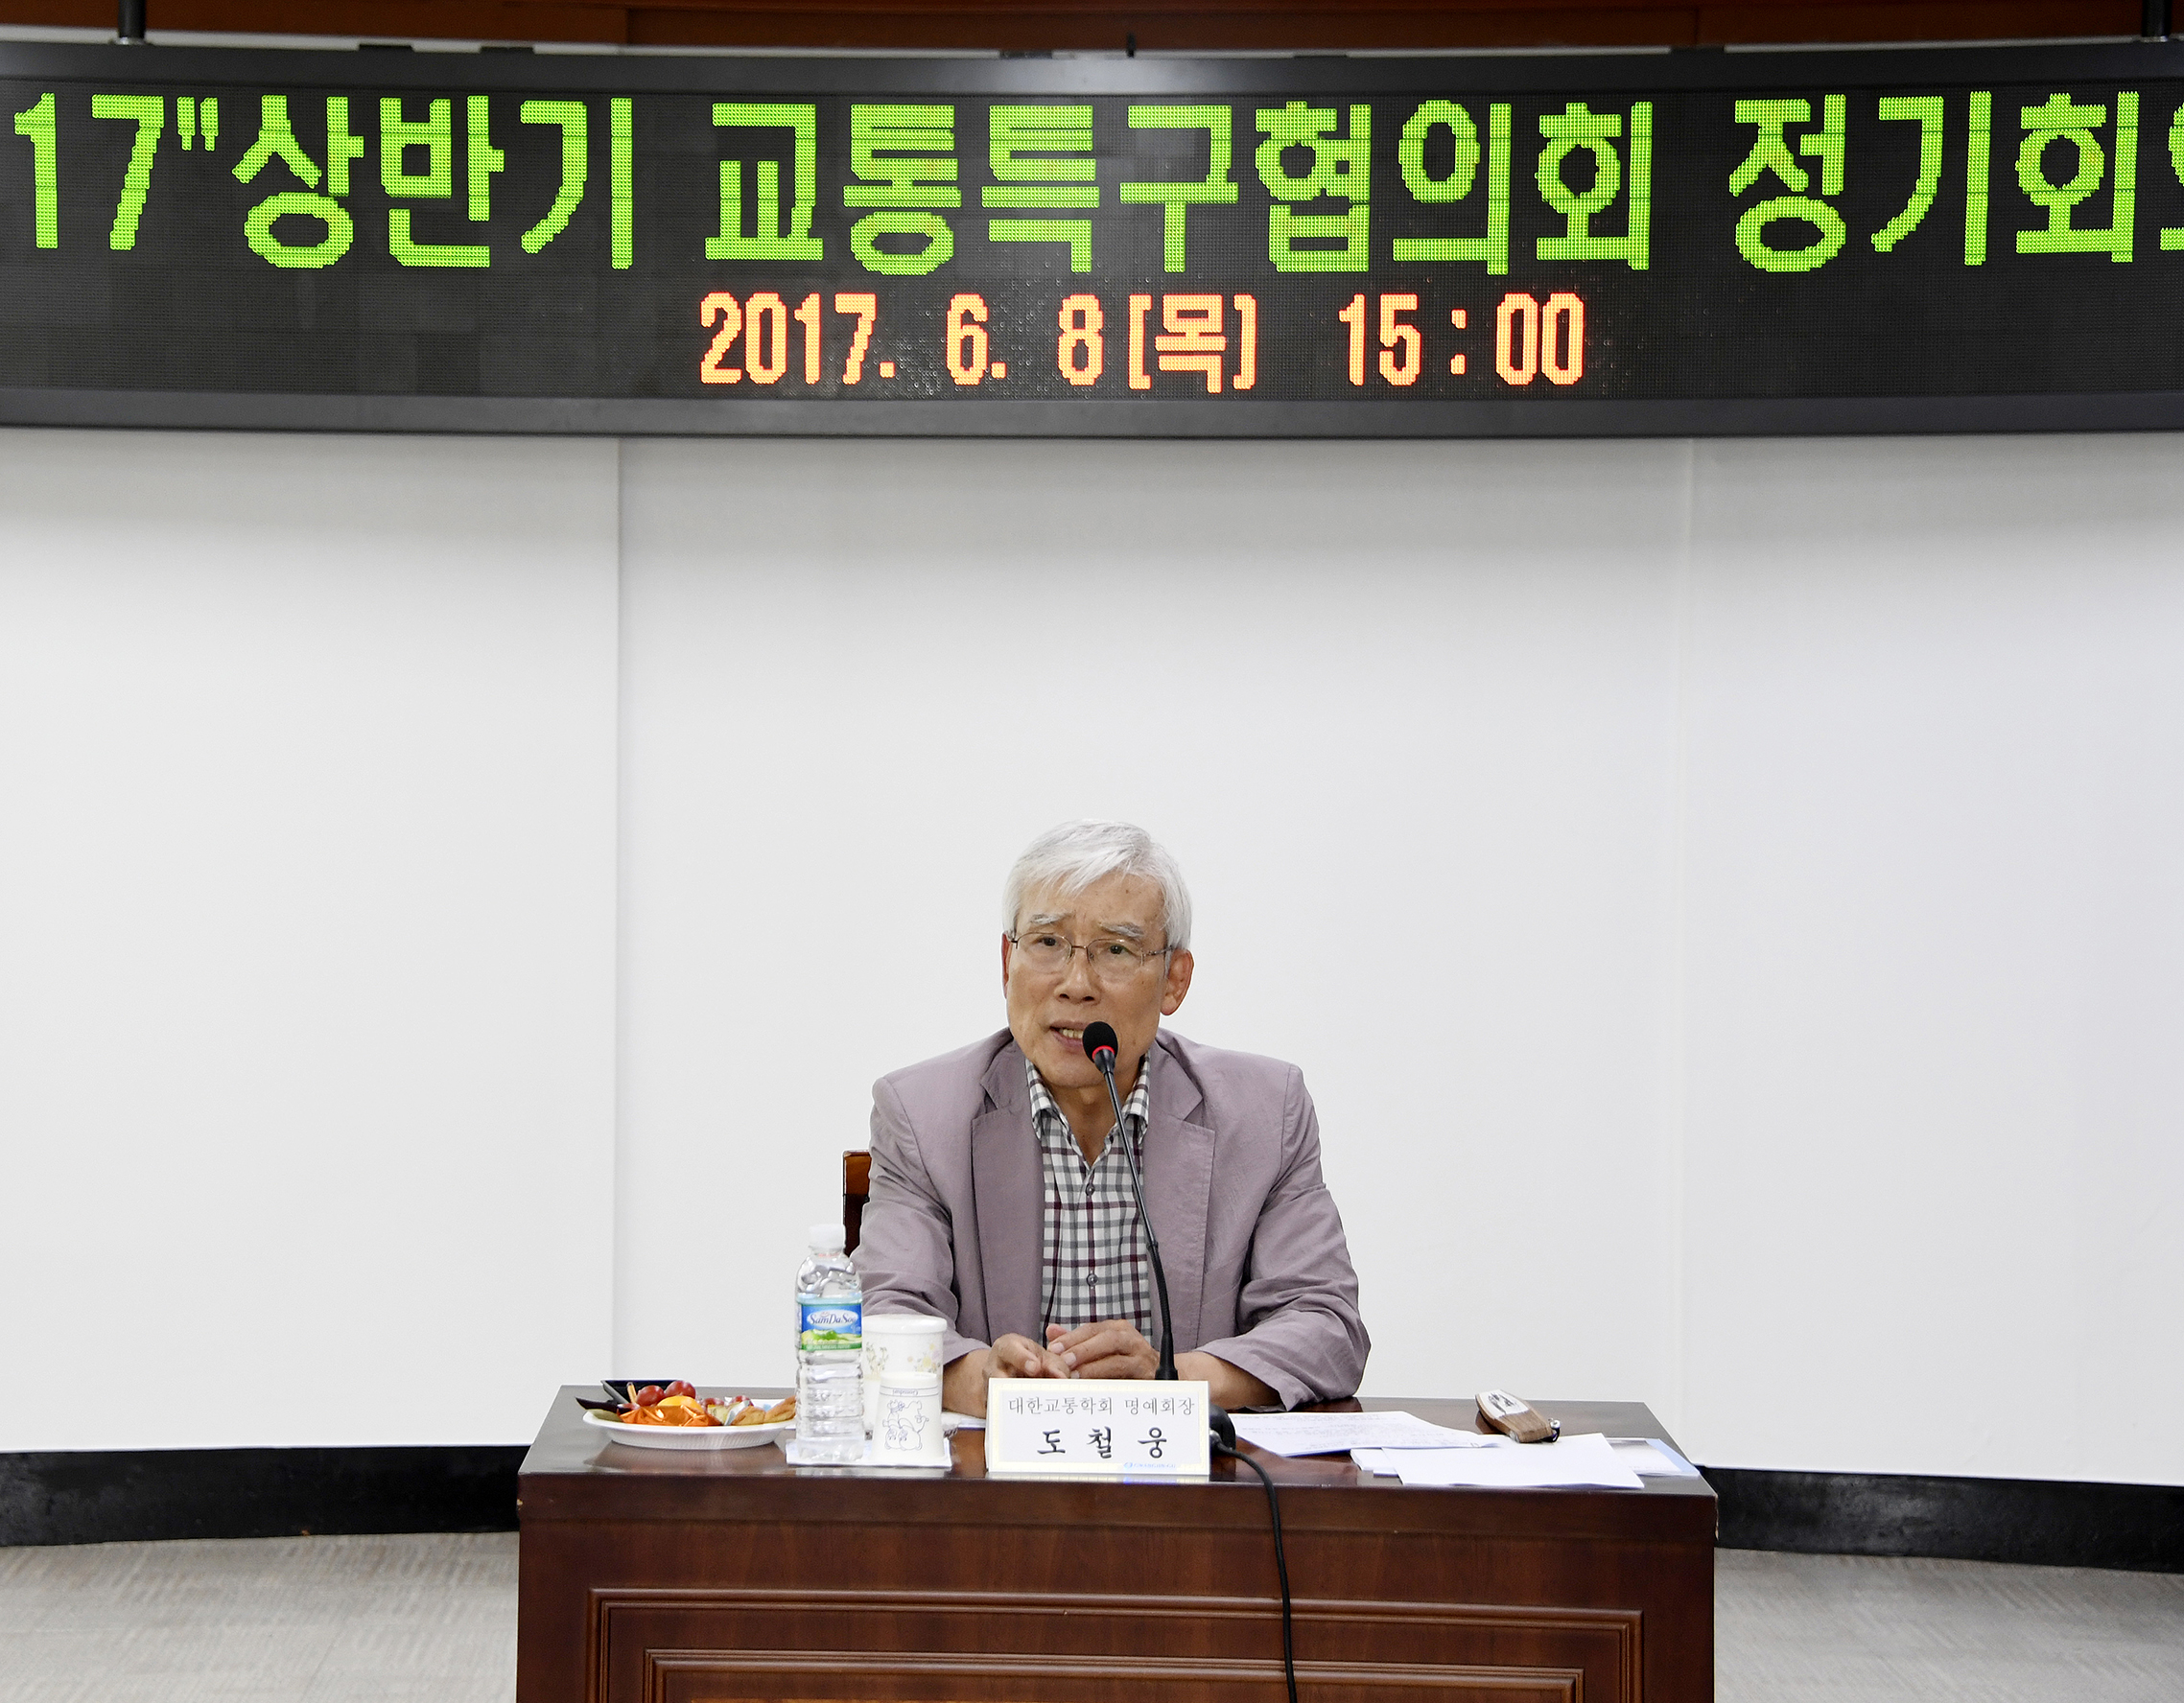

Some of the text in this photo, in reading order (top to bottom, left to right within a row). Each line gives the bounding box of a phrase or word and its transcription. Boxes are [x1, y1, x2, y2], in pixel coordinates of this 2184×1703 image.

[705, 100, 1654, 276] 교통특구협의회
[1727, 91, 2184, 273] 정기회
[699, 292, 896, 385] 2017.
[946, 293, 1007, 385] 6.
[1008, 1396, 1195, 1416] 대한교통학회 명예회장
